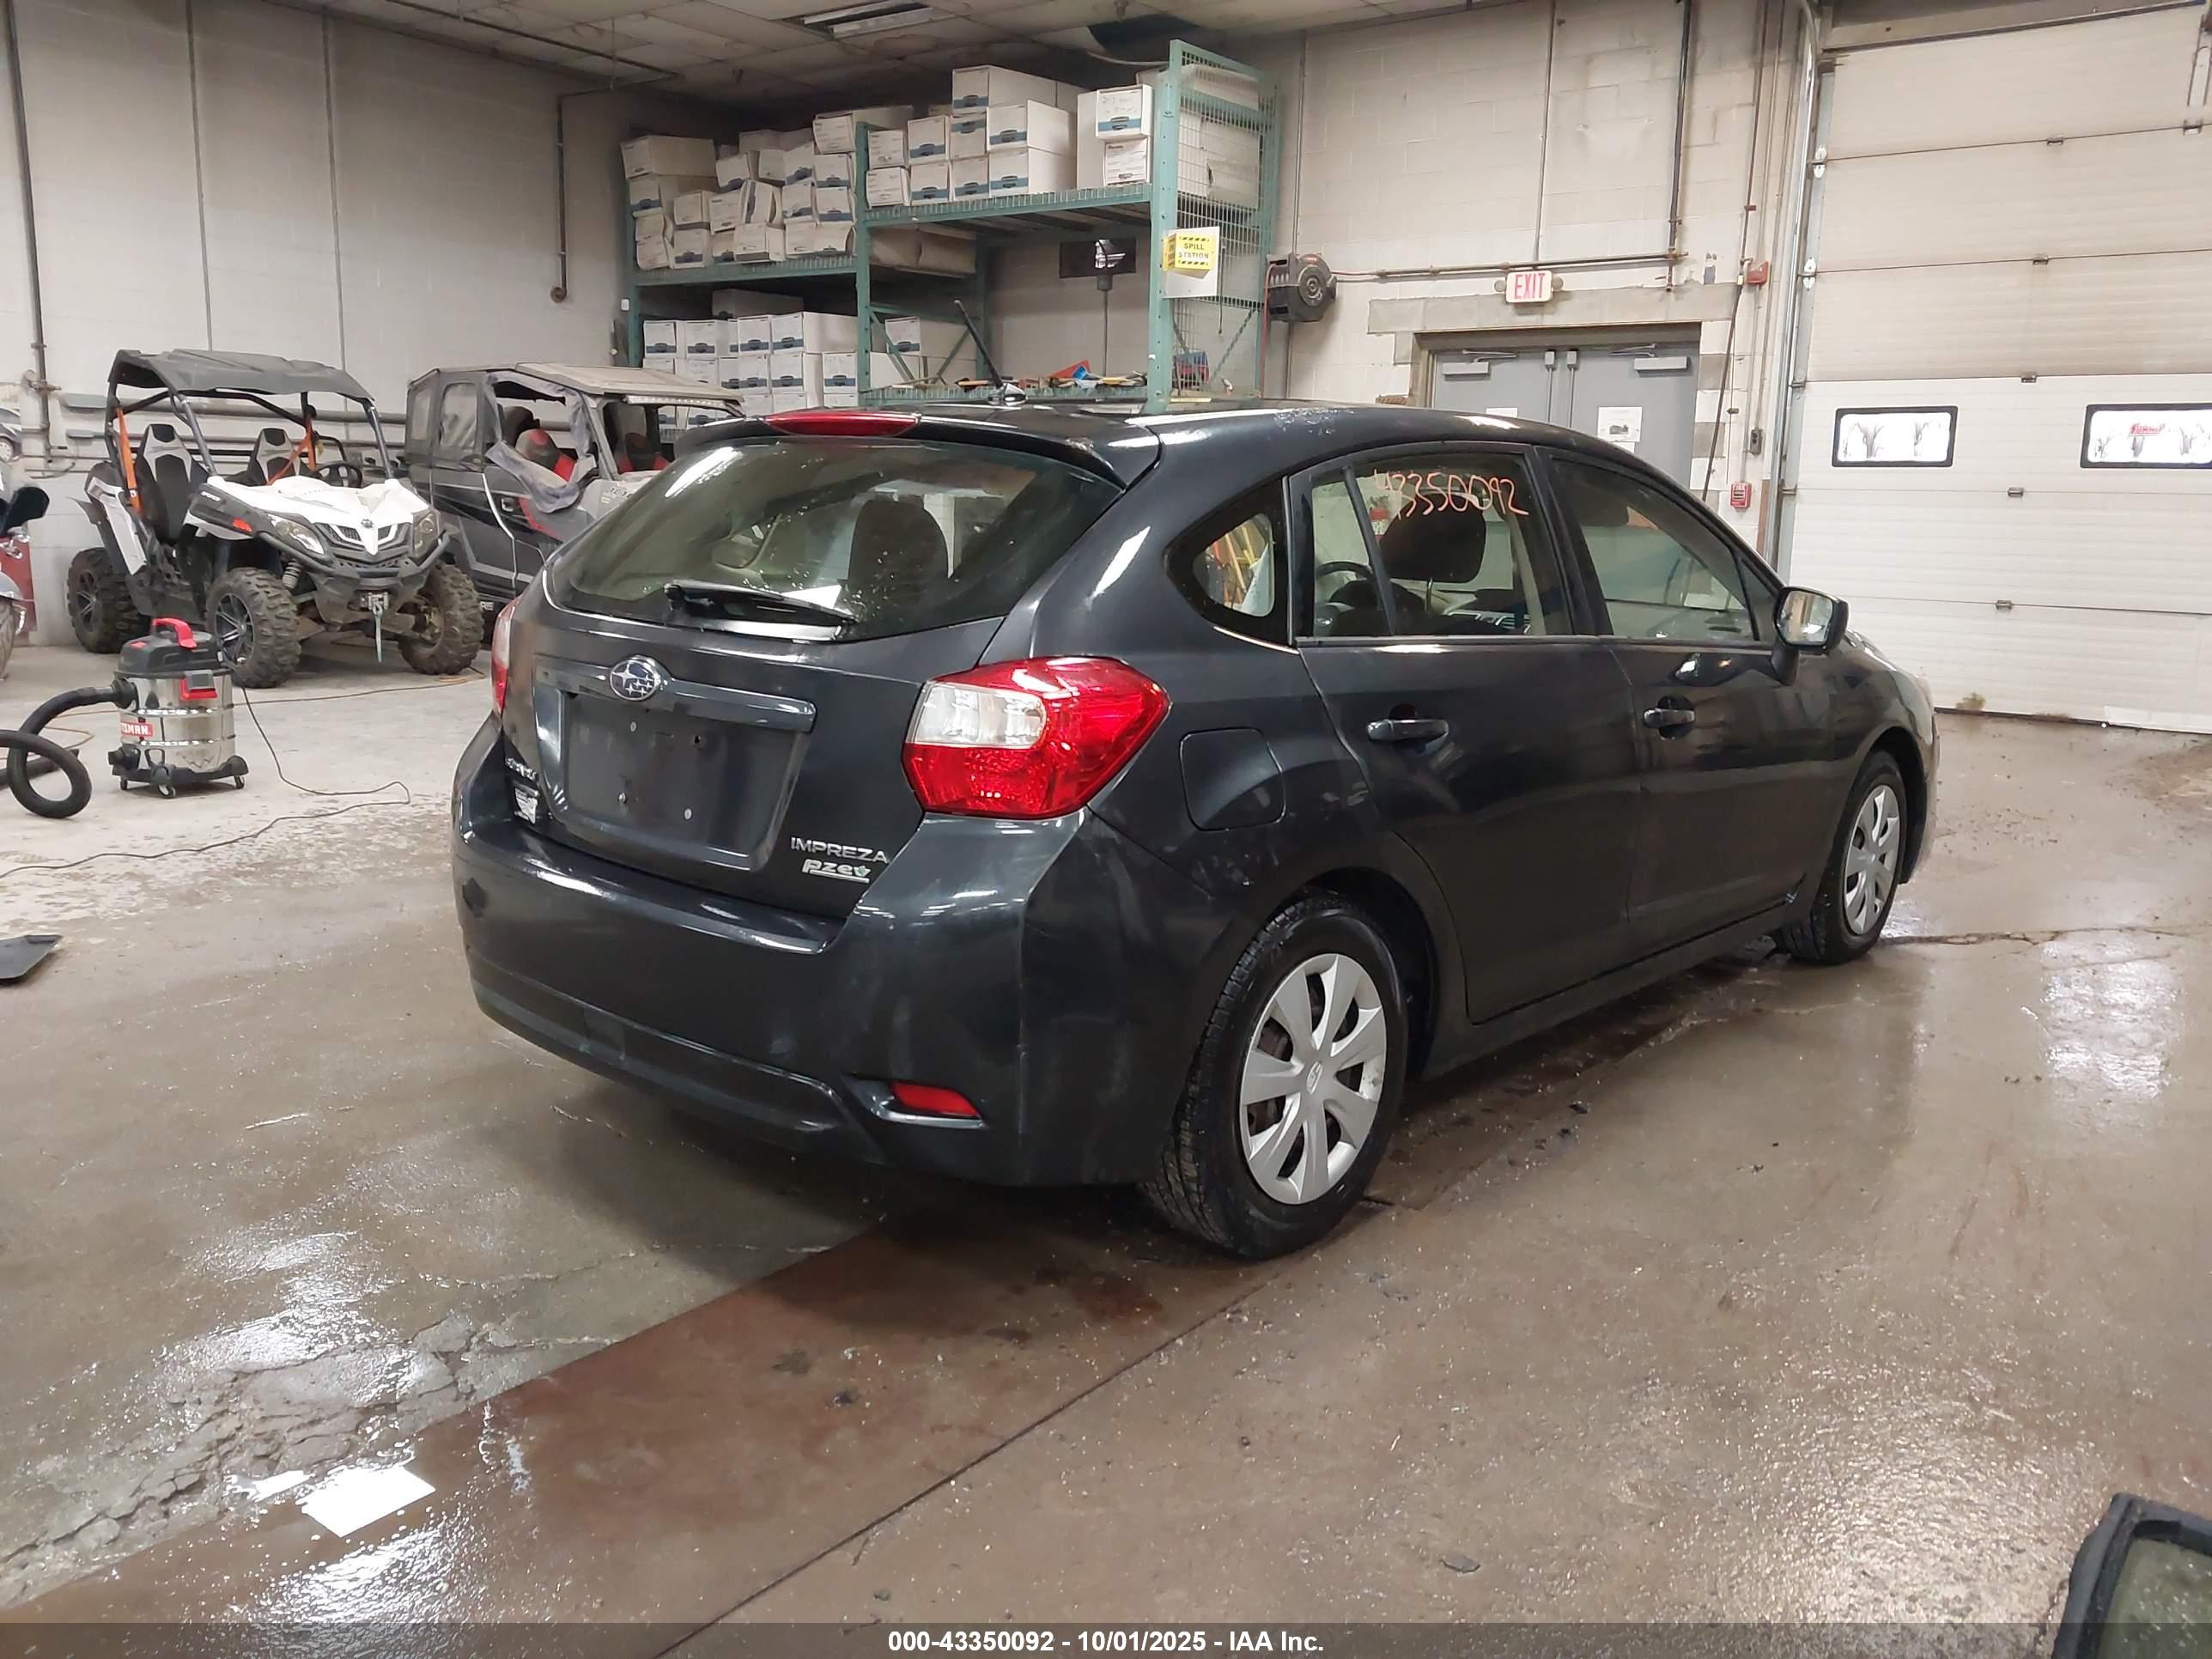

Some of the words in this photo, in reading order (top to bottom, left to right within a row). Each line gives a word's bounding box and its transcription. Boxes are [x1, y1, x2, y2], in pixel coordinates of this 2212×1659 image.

[1183, 242, 1205, 251] SPILL
[1514, 272, 1546, 300] EXIT
[1374, 469, 1530, 520] 43350092
[791, 836, 889, 864] IMPREZA
